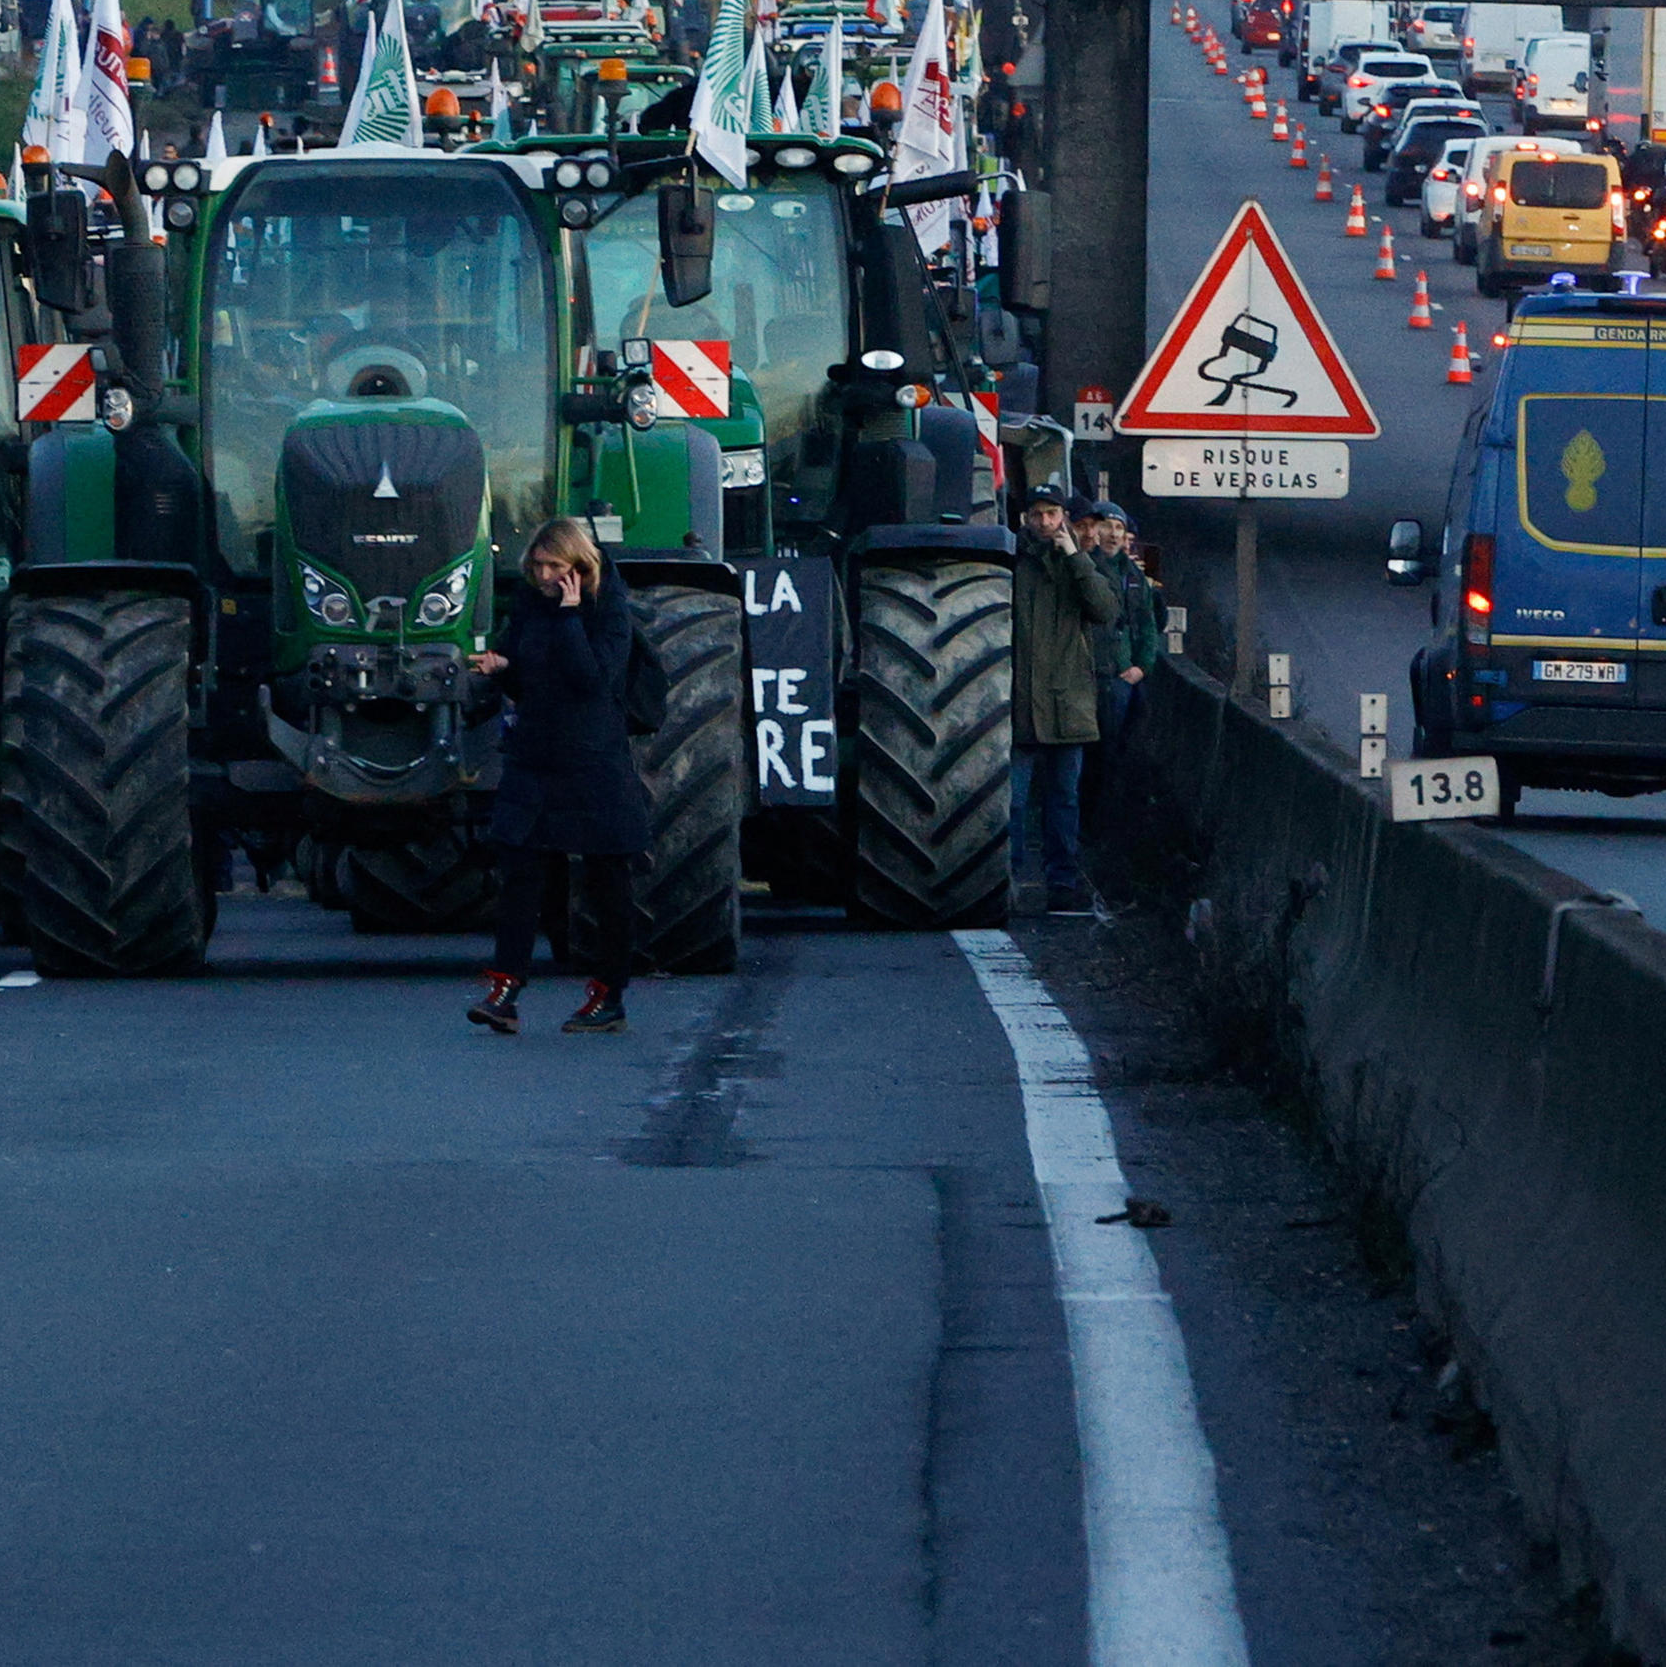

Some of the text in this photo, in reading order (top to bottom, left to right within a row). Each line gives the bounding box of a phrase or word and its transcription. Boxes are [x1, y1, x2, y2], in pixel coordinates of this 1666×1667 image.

[1081, 412, 1107, 431] 14
[1203, 449, 1290, 466] RISQUE
[1173, 472, 1319, 489] DE VERGLAS
[744, 569, 803, 616] LA
[1516, 607, 1566, 622] IVECO
[1410, 770, 1484, 806] 13.8
